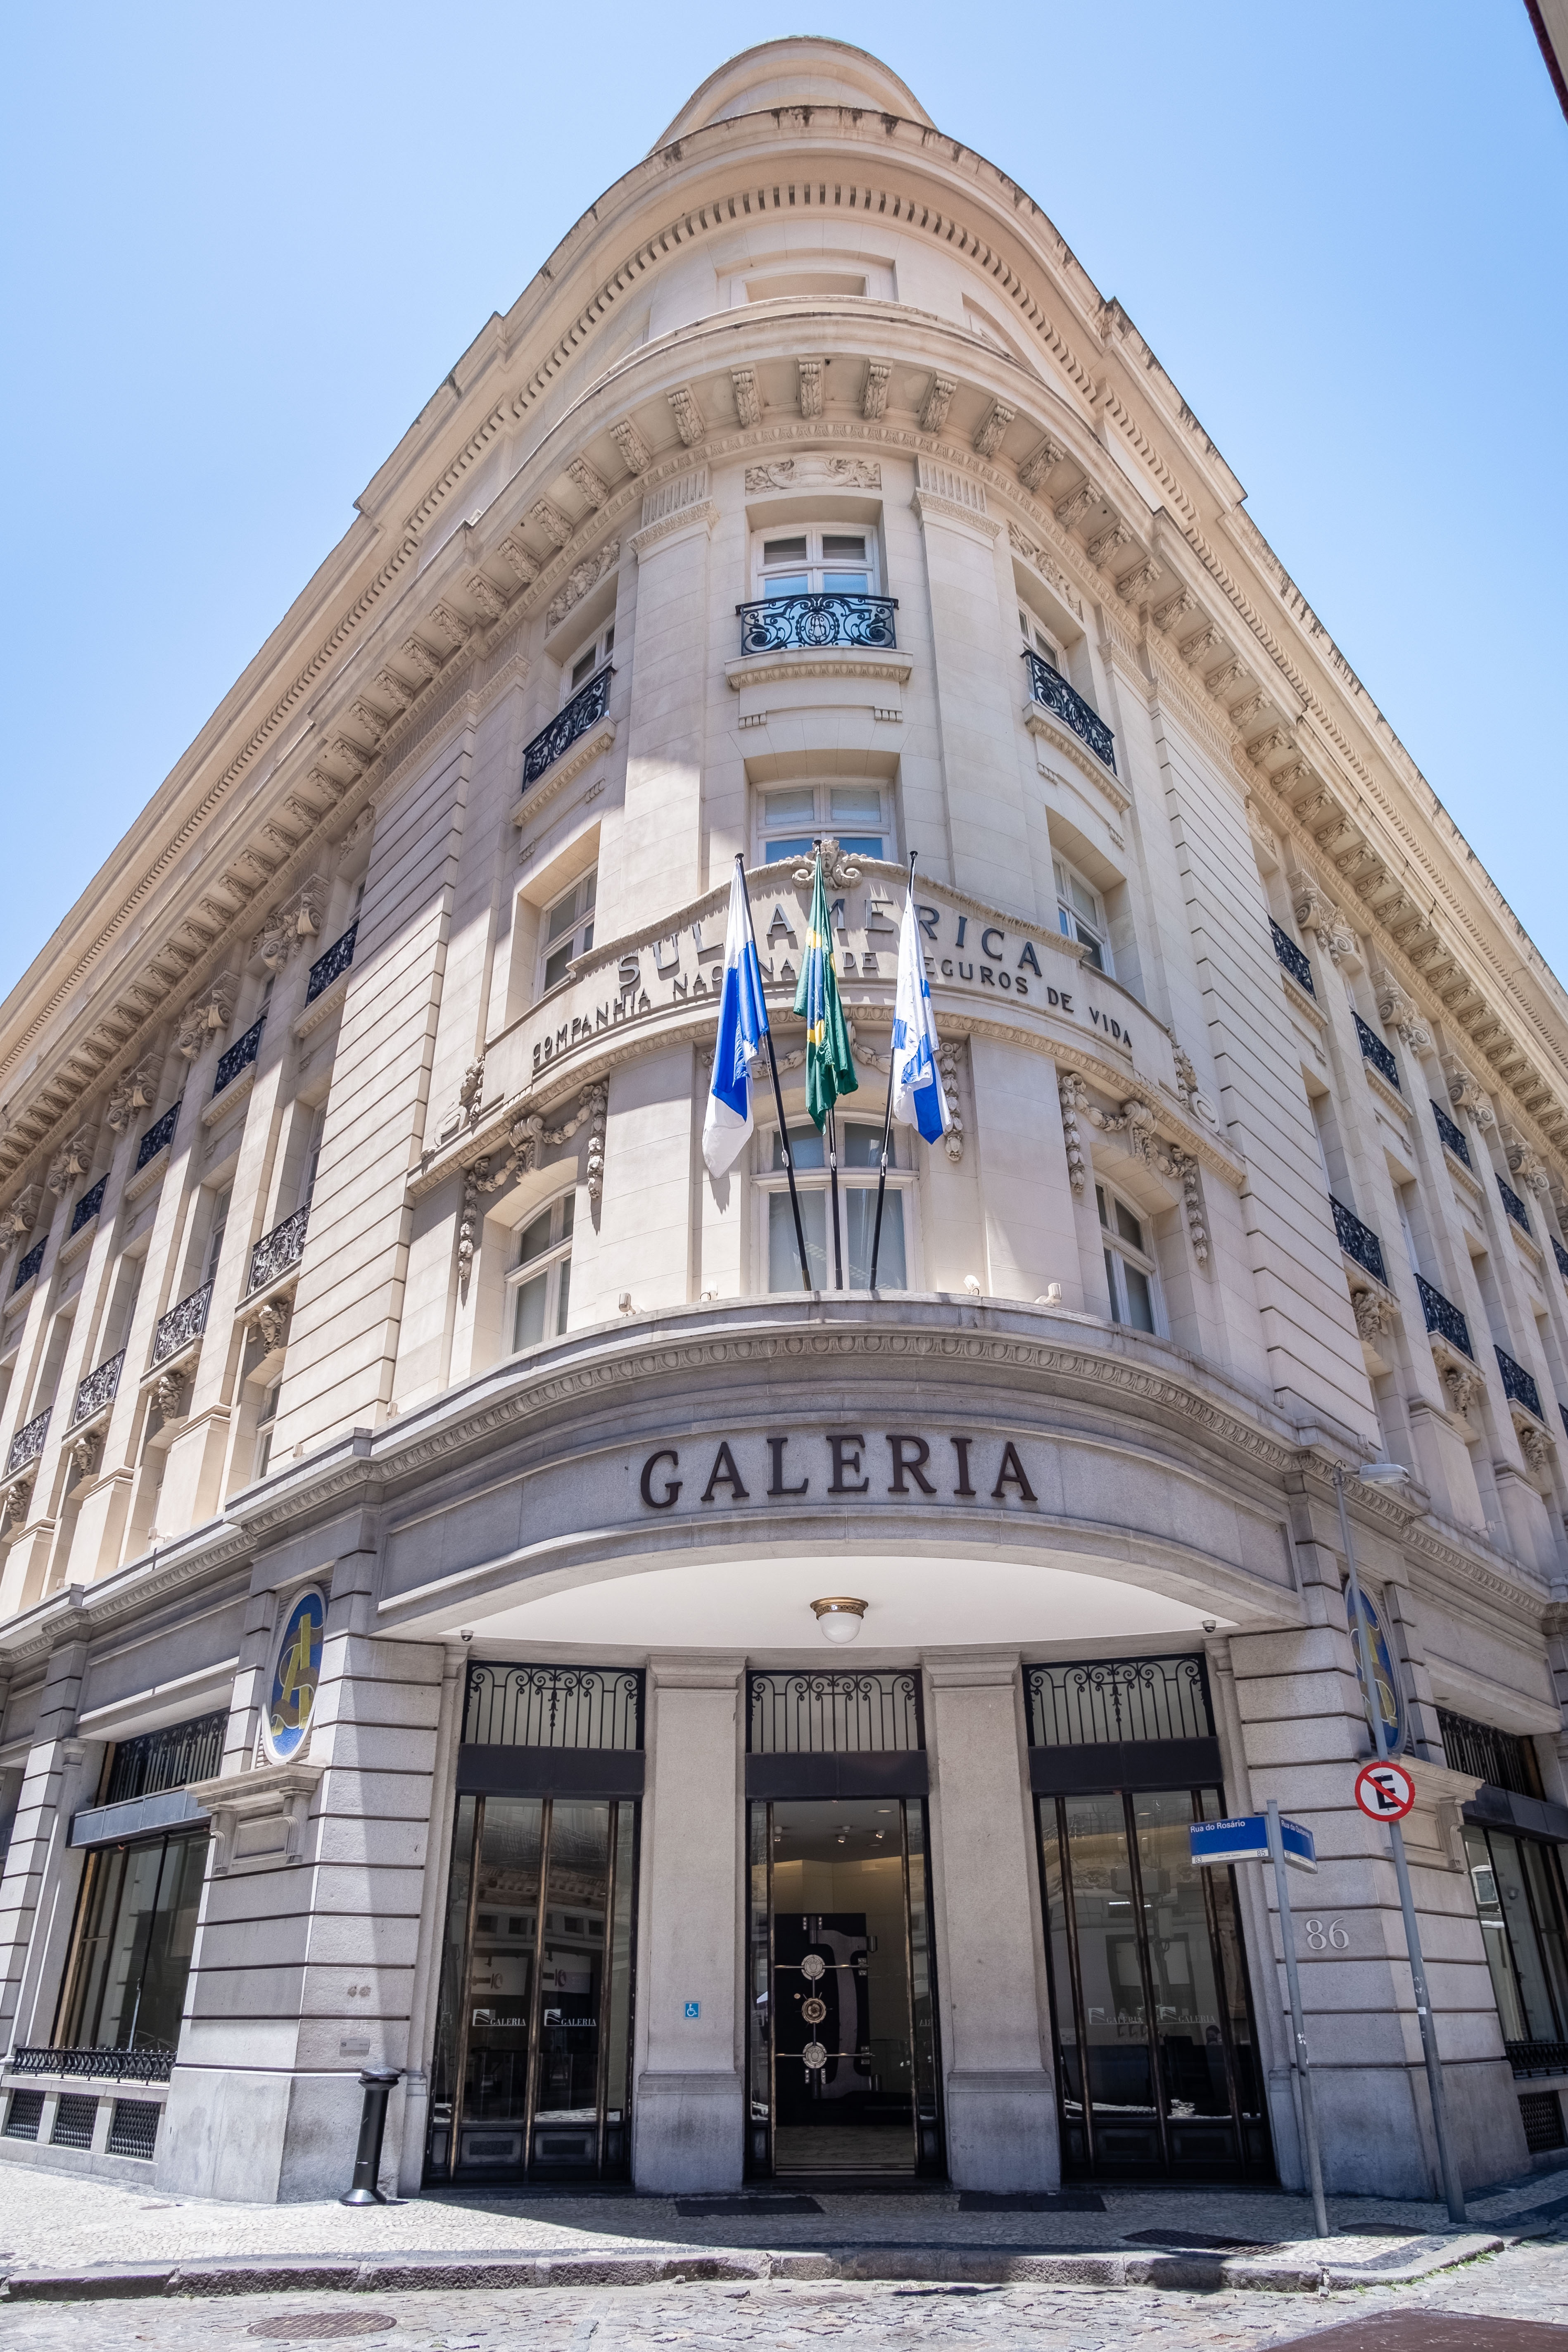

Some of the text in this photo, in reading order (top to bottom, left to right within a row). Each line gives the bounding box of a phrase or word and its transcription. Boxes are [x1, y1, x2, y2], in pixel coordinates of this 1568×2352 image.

[617, 923, 724, 990] SUL
[532, 989, 651, 1061] COMPANHIA
[842, 951, 877, 969] DE
[923, 956, 1029, 993] EGUROS
[1047, 986, 1074, 1013] DE
[1088, 1006, 1133, 1048] VIDA
[640, 1434, 1038, 1509] GALERIA
[1216, 1820, 1245, 1829] Rosário
[1281, 1820, 1290, 1829] Rua
[1305, 1918, 1349, 1950] 86
